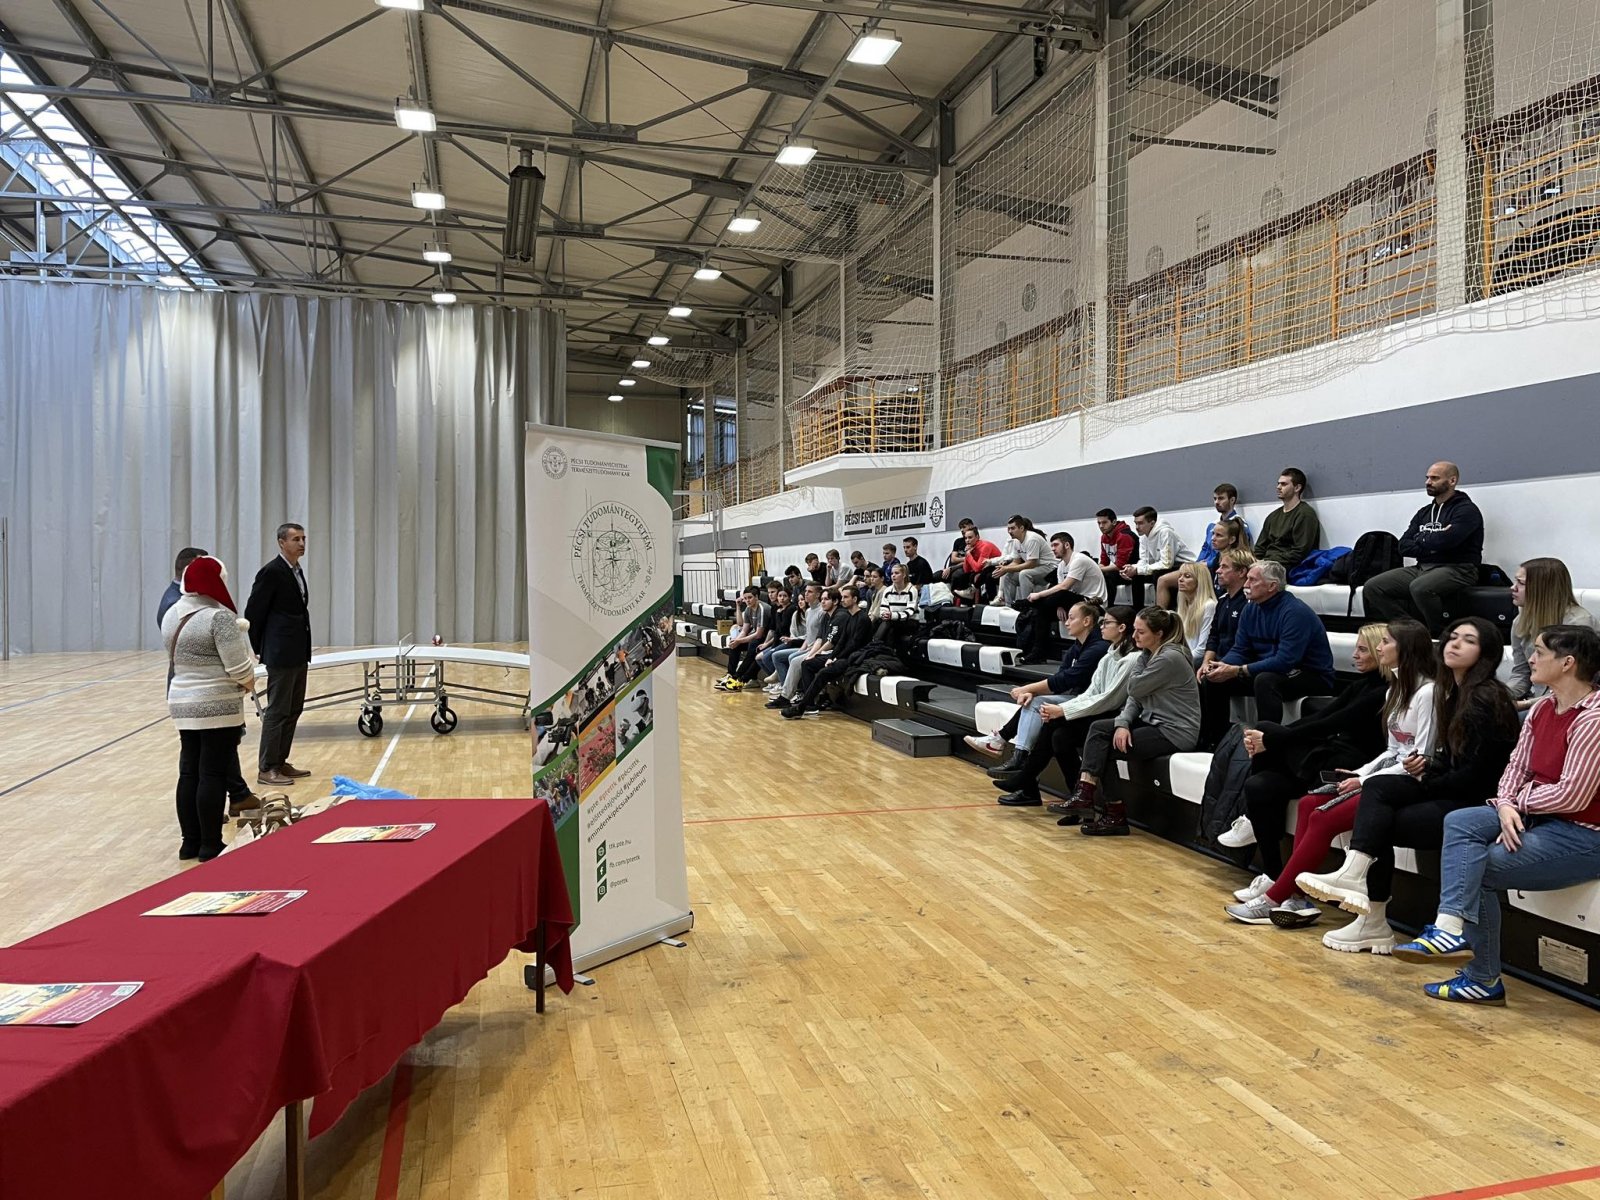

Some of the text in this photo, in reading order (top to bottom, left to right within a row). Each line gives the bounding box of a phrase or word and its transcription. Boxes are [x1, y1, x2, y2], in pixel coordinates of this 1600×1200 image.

[844, 501, 927, 525] PÉCSI EGYETEMI ATLÉTIKAI
[574, 503, 653, 558] PÉCSI TUDOMÁNYEGYETEM
[874, 524, 888, 535] CLUB
[577, 573, 635, 617] TERMÉSZETTUDOMÁNYI
[634, 590, 647, 608] KAR
[623, 764, 648, 790] #jubileum
[587, 800, 599, 814] #pte
[599, 780, 617, 801] #ptettk
